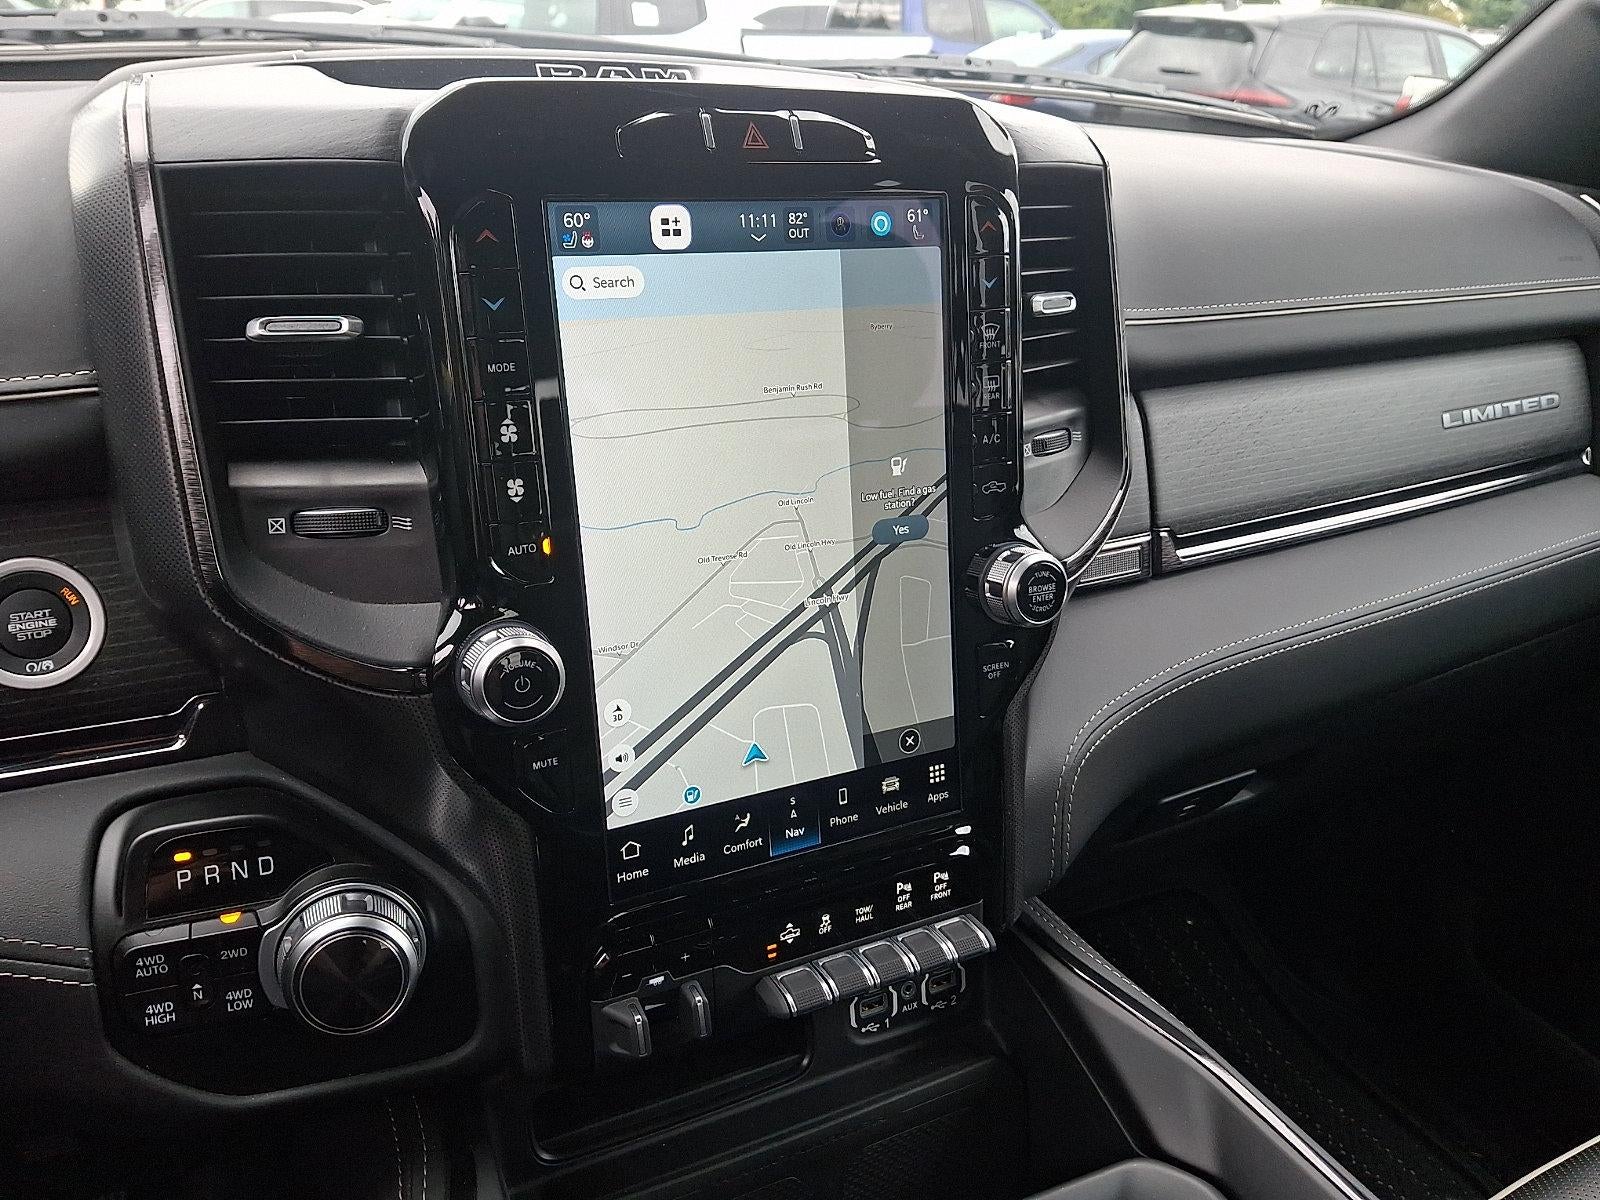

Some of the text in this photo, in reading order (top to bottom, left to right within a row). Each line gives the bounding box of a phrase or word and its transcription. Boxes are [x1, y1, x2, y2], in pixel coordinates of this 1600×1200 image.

[563, 212, 591, 228] 60°
[739, 213, 777, 228] 11:11
[788, 212, 808, 225] 82°
[906, 208, 929, 223] 61°
[788, 228, 810, 239] OUT
[593, 275, 635, 289] Search
[979, 340, 1001, 349] FRONT
[487, 362, 516, 374] MODE
[763, 385, 795, 395] Benjamin
[813, 382, 823, 390] Rd
[1442, 392, 1560, 429] LIMITED
[983, 434, 1001, 444] A/C
[861, 491, 879, 502] Low
[879, 489, 897, 500] fuel.
[898, 487, 916, 497] Find
[922, 485, 937, 496] gas
[777, 496, 814, 507] Old Lincoln
[884, 498, 916, 510] station?
[893, 525, 910, 536] Yes
[508, 543, 537, 556] AUTO
[784, 539, 836, 551] Old Lincoln Hwy
[697, 550, 748, 564] Old Trevose Rd
[1034, 570, 1051, 578] TUNE
[1028, 582, 1056, 594] BROWSE
[60, 586, 80, 607] RUN
[804, 593, 849, 607] Lincoln Hwy
[1032, 593, 1054, 603] ENTER
[1031, 603, 1053, 612] SCROLL
[9, 608, 52, 622] START
[7, 618, 58, 633] ENGINE
[16, 629, 53, 641] STOP
[597, 641, 639, 654] Windsor Dr
[503, 660, 537, 674] VOLUME
[982, 661, 1010, 673] SCREEN
[988, 671, 1001, 680] OFF
[612, 713, 623, 723] 3D
[532, 757, 559, 771] MUTE
[927, 790, 949, 804] Apps
[875, 800, 909, 816] Vehicle
[829, 812, 859, 828] Phone
[785, 826, 805, 839] Nav
[723, 836, 764, 855] Comfort
[673, 852, 706, 869] Media
[176, 855, 275, 890] P R N D
[616, 867, 650, 884] Home
[934, 882, 948, 892] OFF
[897, 893, 911, 903] OFF
[930, 888, 952, 902] FRONT
[855, 904, 874, 916] TOW/
[895, 900, 913, 912] REAR
[855, 912, 874, 924] HAUL
[818, 924, 833, 935] OFF
[220, 947, 248, 960] 2WD
[135, 954, 165, 967] 4WD
[135, 964, 169, 979] AUTO
[192, 990, 203, 1001] N
[225, 988, 253, 1001] 4WD
[950, 994, 957, 1006] 2
[145, 1001, 174, 1015] 4WD
[227, 998, 254, 1012] LOW
[901, 1001, 919, 1013] AUX
[144, 1012, 176, 1027] HIGH
[884, 1018, 890, 1029] 1
